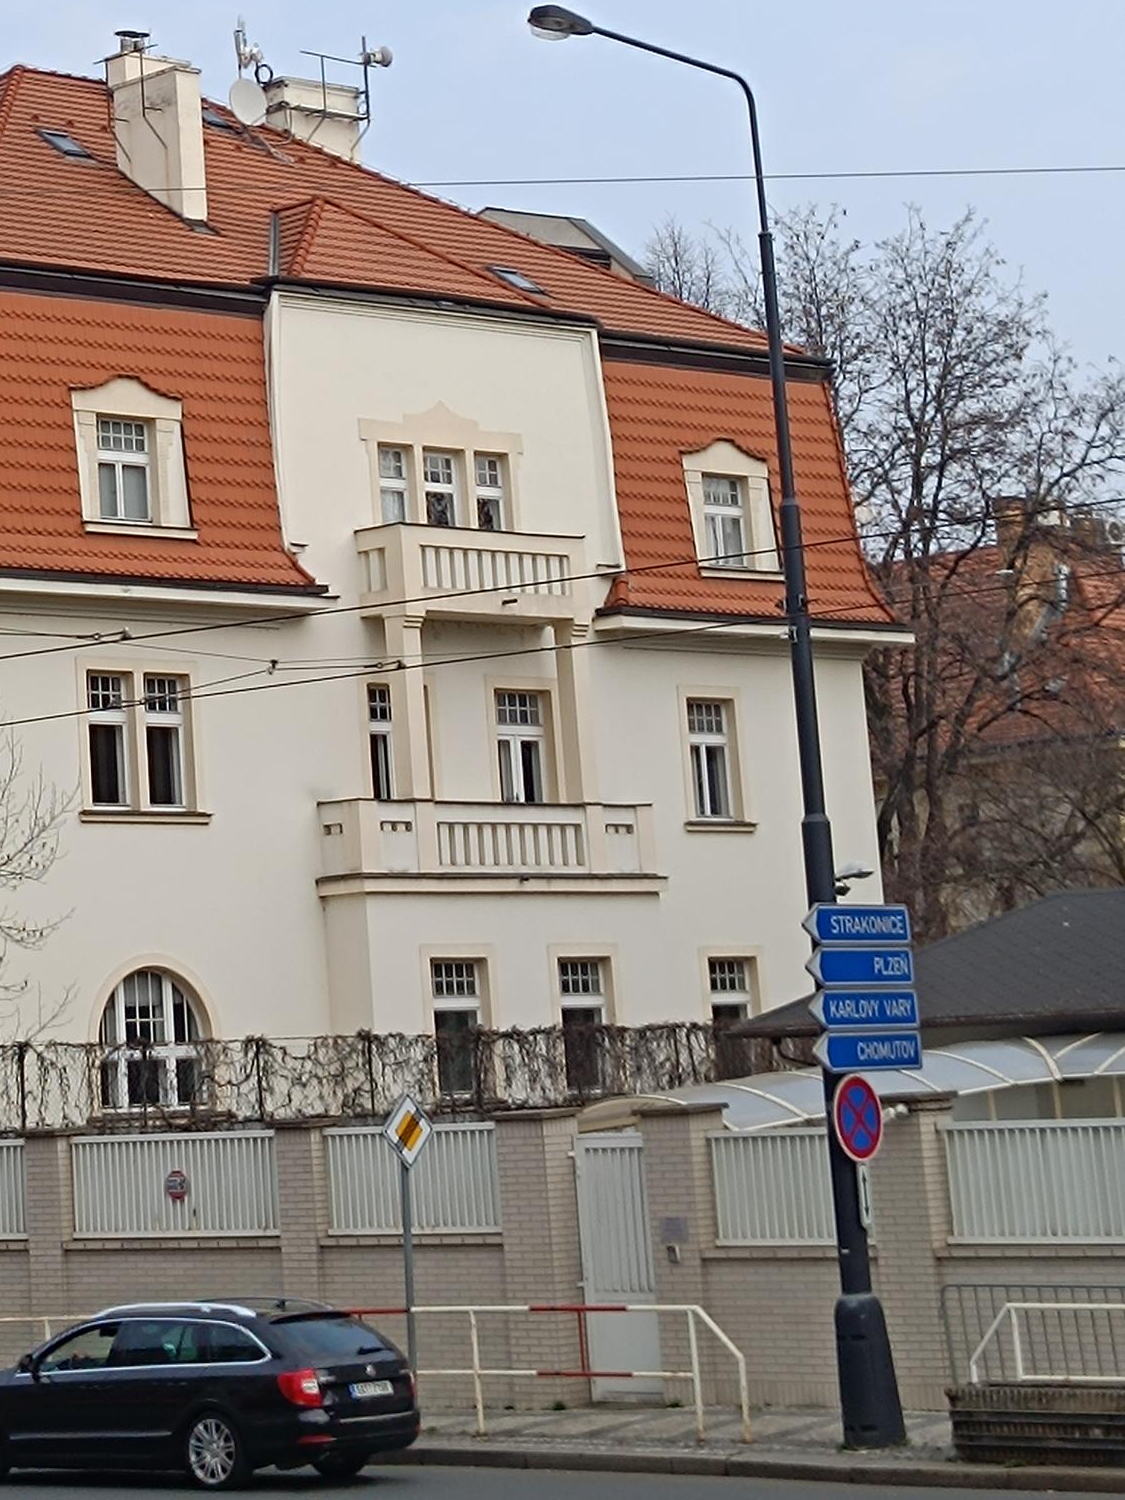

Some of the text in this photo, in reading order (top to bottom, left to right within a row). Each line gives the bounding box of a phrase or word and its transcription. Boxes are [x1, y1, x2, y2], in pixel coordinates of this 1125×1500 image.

[830, 915, 905, 934] STRAKONICE
[874, 953, 908, 975] PLZEŇ
[829, 999, 912, 1018] KARLOVY VARY
[857, 1041, 916, 1061] CHOMUTOV
